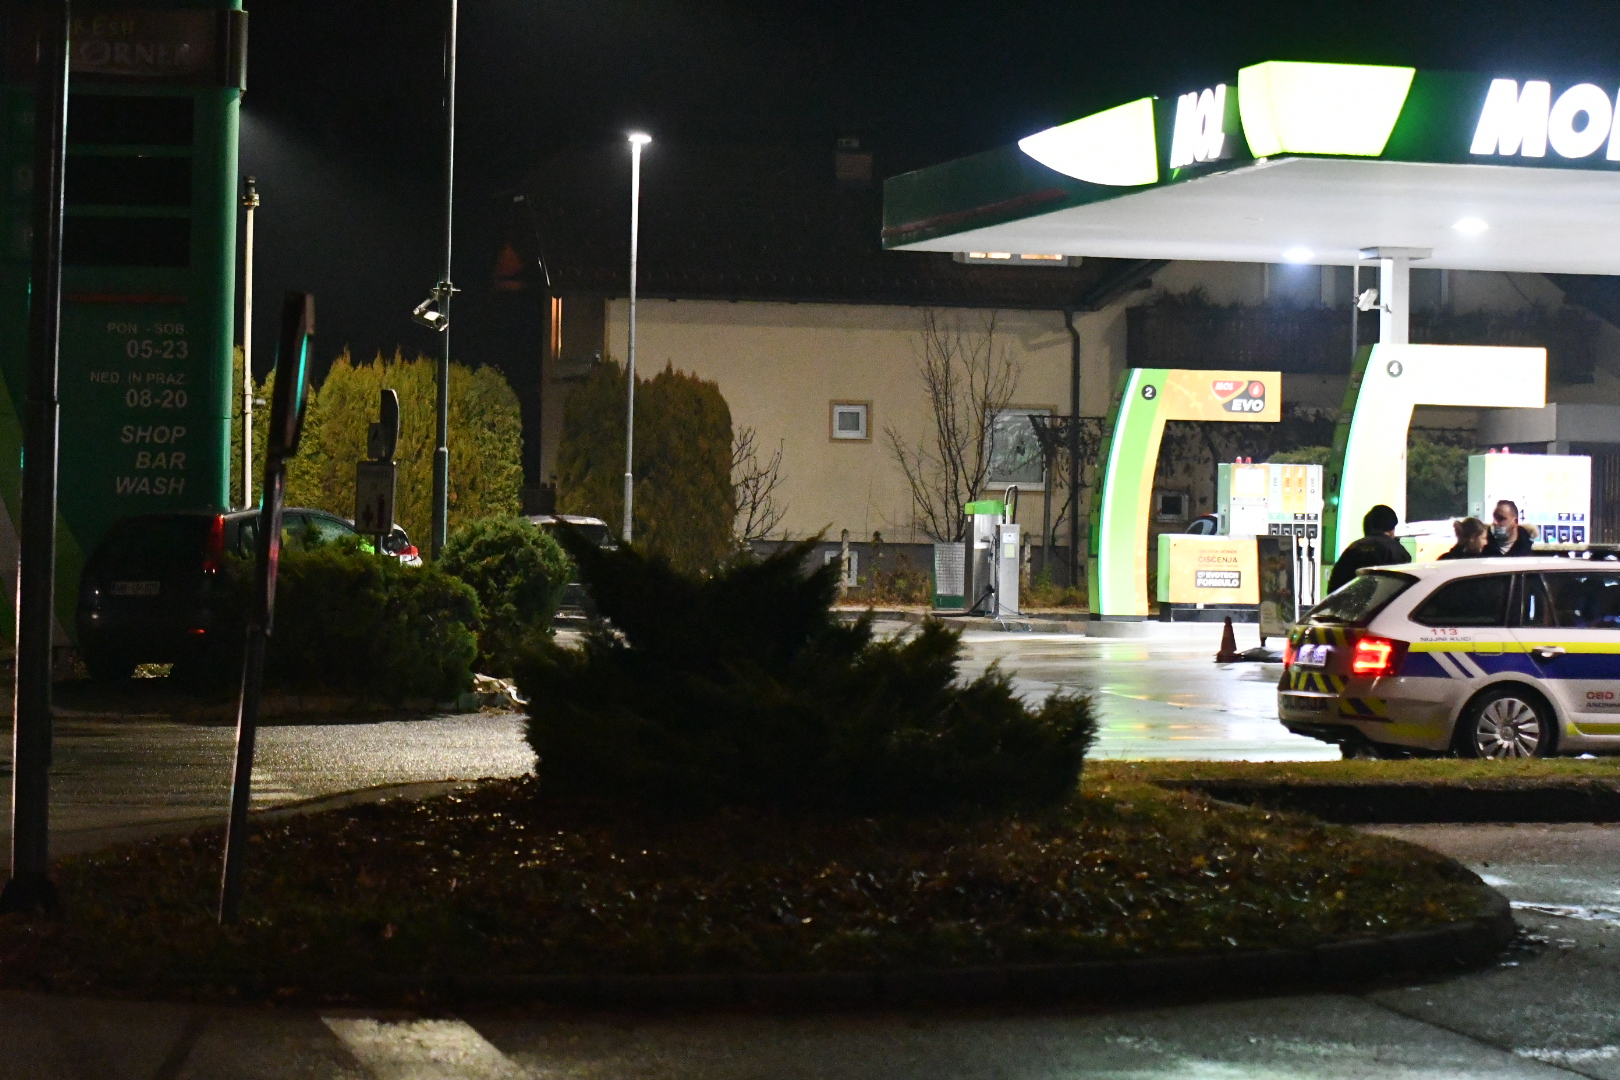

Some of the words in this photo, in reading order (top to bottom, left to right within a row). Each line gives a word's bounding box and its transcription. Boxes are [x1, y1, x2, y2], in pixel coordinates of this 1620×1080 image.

[1170, 84, 1226, 168] MOL
[107, 323, 138, 334] PON
[154, 323, 185, 335] SOB
[126, 339, 189, 359] 05-23
[90, 371, 120, 383] NED
[128, 371, 142, 383] IN
[146, 372, 187, 385] PRAZ
[1215, 381, 1234, 391] MOL
[125, 388, 188, 409] 08-20
[1231, 398, 1264, 412] EVO
[119, 425, 187, 444] SHOP
[135, 451, 187, 470] BAR
[116, 476, 186, 496] WASH
[1198, 554, 1238, 563] ČIŠČENJA
[1205, 571, 1239, 579] EVOTECH
[1196, 578, 1240, 587] FORMULO
